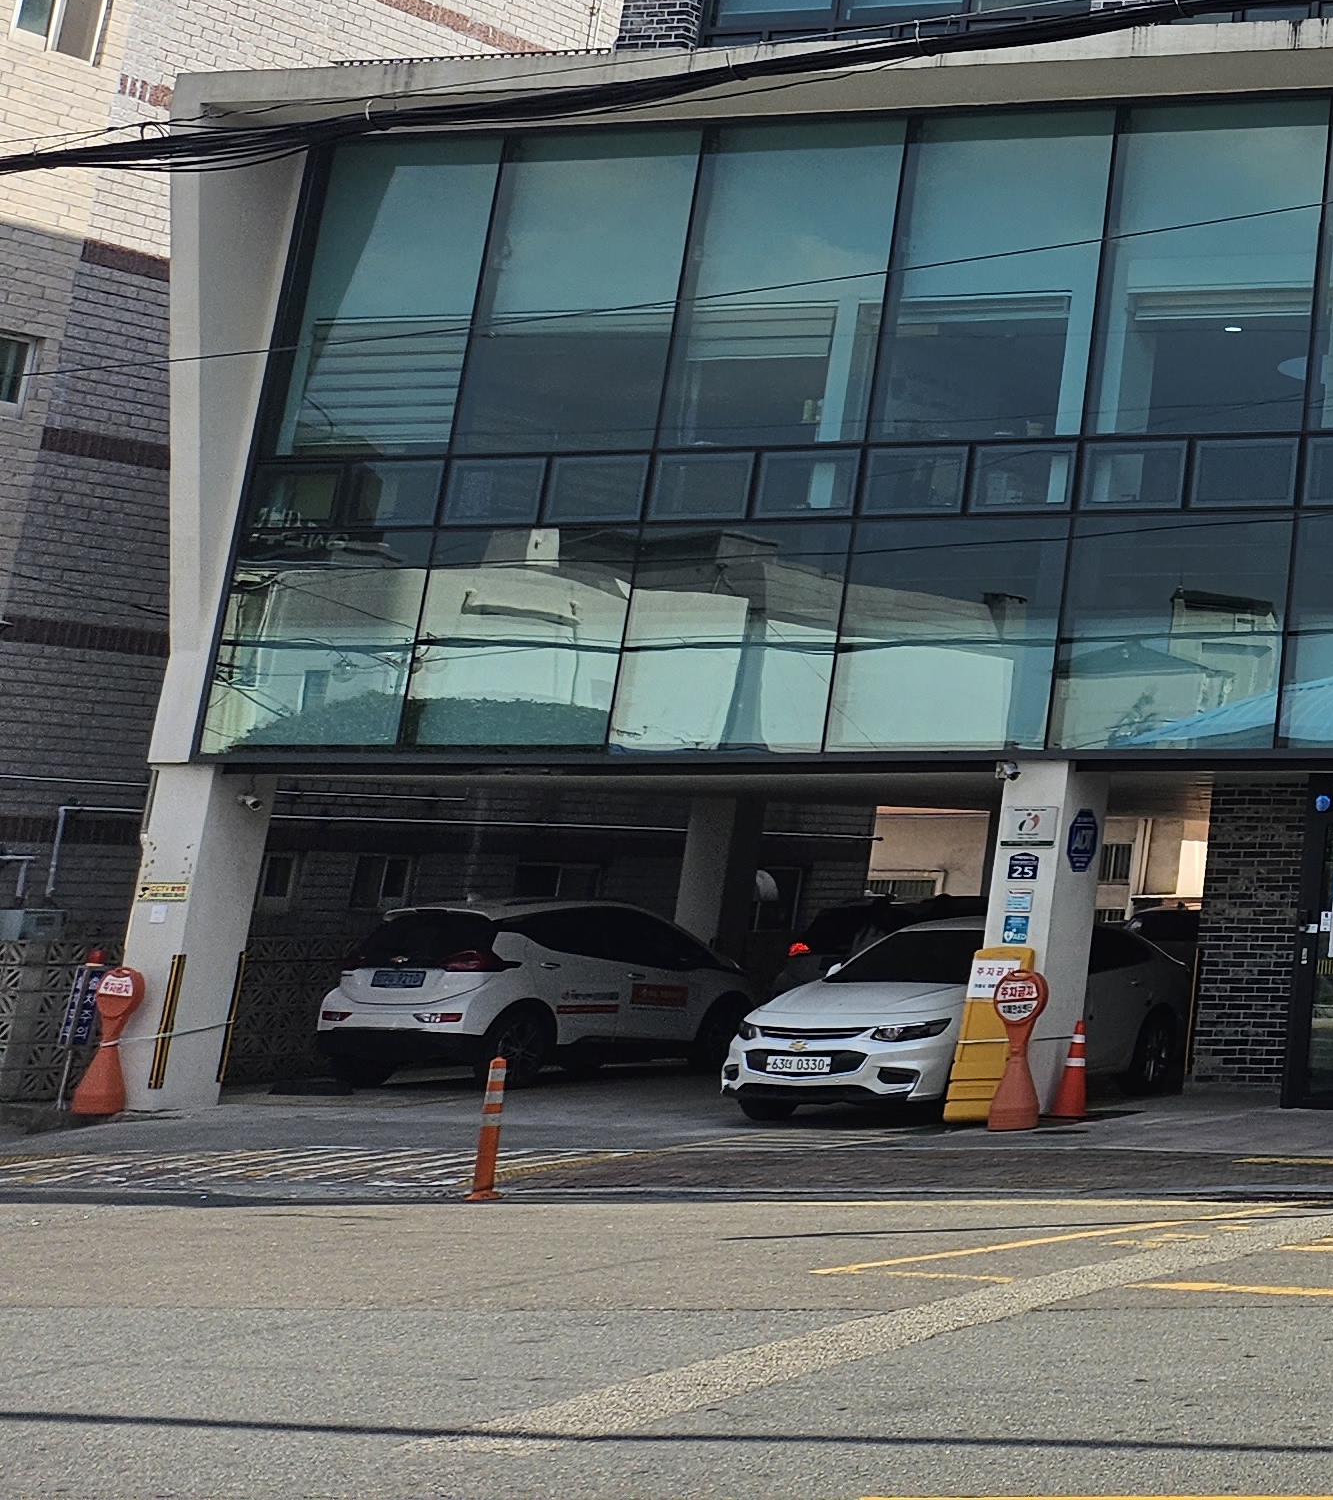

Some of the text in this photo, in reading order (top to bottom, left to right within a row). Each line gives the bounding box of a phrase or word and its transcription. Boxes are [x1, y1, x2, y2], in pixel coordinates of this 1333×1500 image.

[1011, 866, 1034, 878] 25
[1000, 985, 1034, 999] 주차금지
[796, 1058, 825, 1071] 0330
